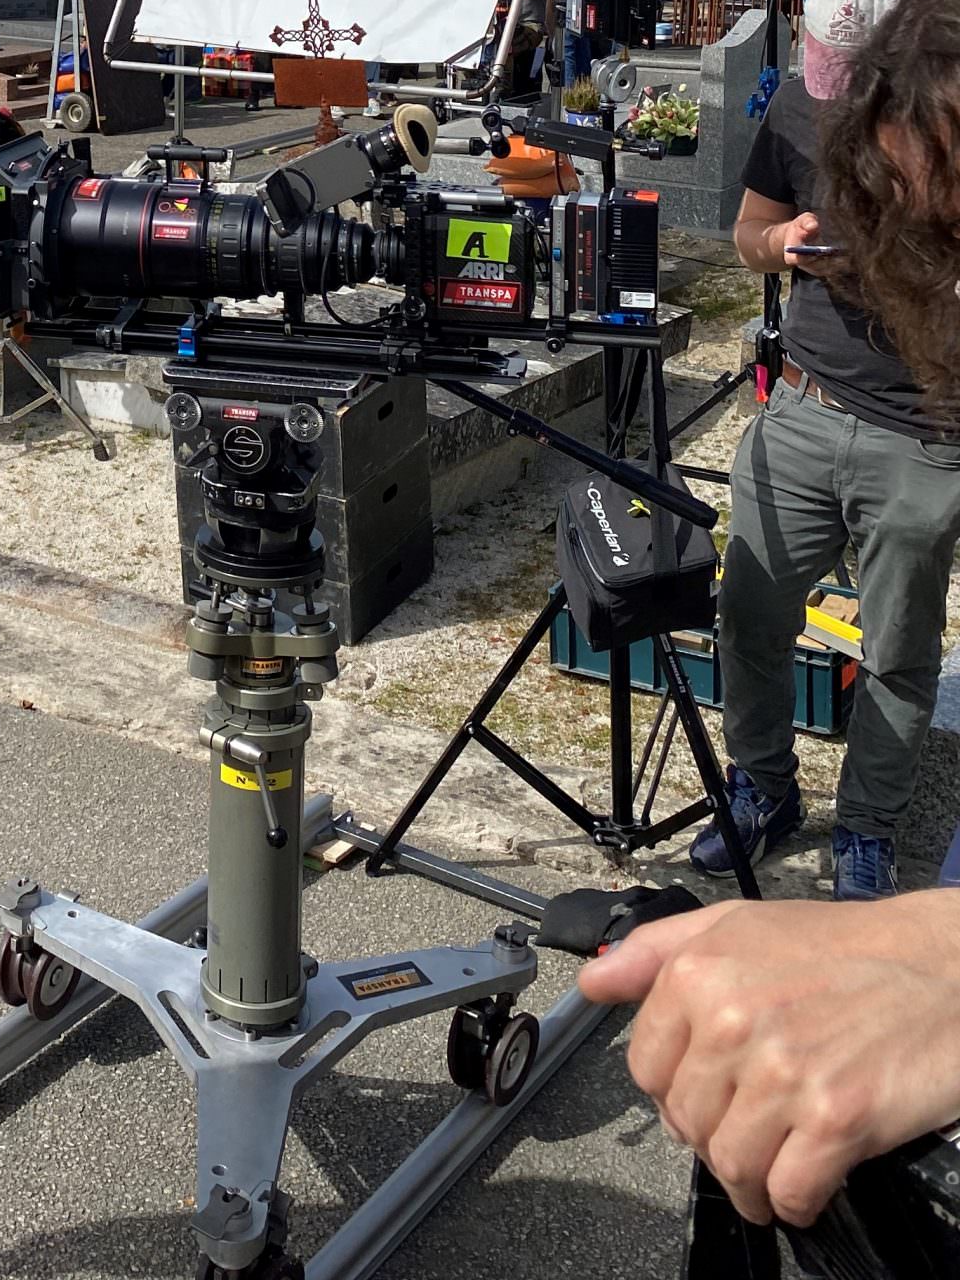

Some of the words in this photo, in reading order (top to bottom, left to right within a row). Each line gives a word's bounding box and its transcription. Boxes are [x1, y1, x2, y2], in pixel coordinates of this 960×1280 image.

[461, 231, 490, 258] A
[457, 261, 505, 281] ARRI
[459, 286, 512, 300] TRANSPA
[231, 408, 258, 418] TRANSPA
[587, 487, 622, 552] Caperlan
[251, 661, 282, 670] TRANSPA
[357, 976, 407, 993] TRANSPA
